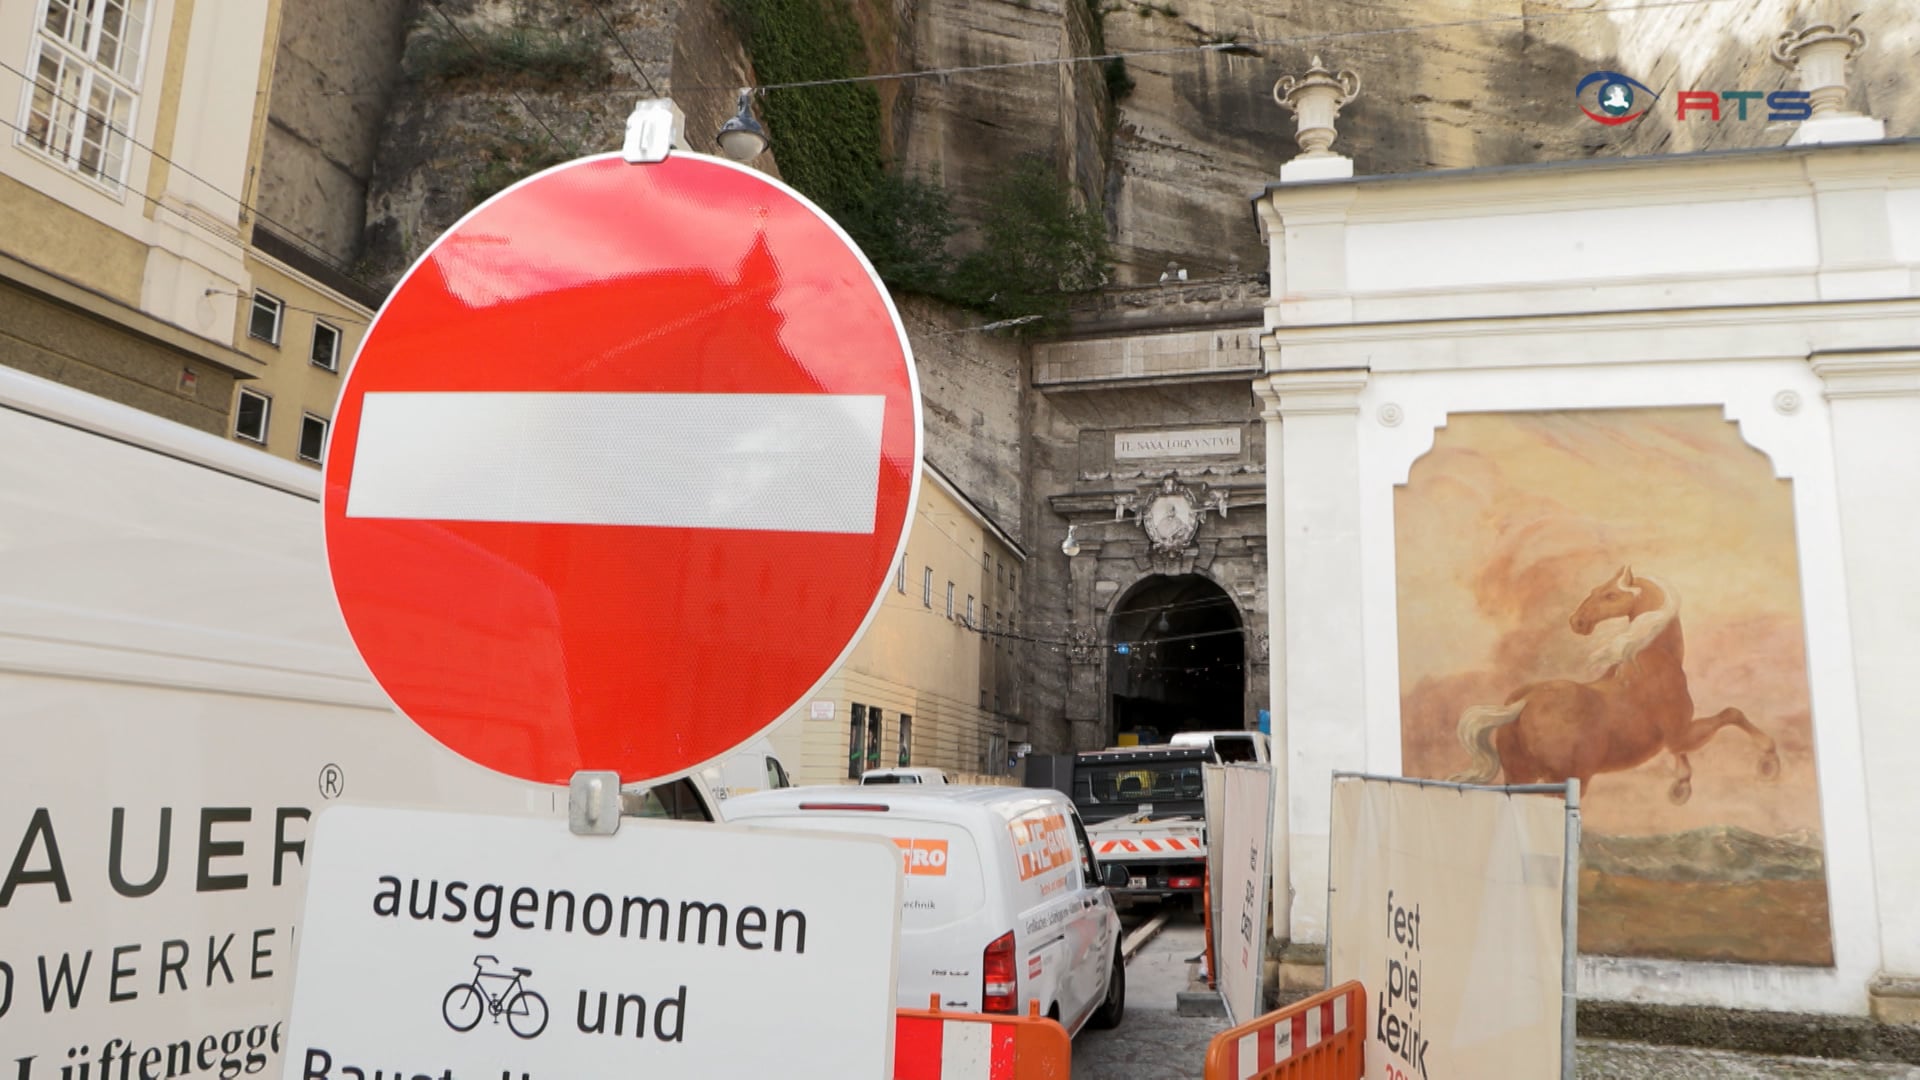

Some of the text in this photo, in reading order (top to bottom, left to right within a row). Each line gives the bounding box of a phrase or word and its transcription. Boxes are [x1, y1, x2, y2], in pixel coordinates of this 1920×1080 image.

[372, 875, 808, 954] ausgenommen
[1387, 889, 1420, 951] fest
[1386, 951, 1421, 1013] piel
[576, 985, 687, 1043] und
